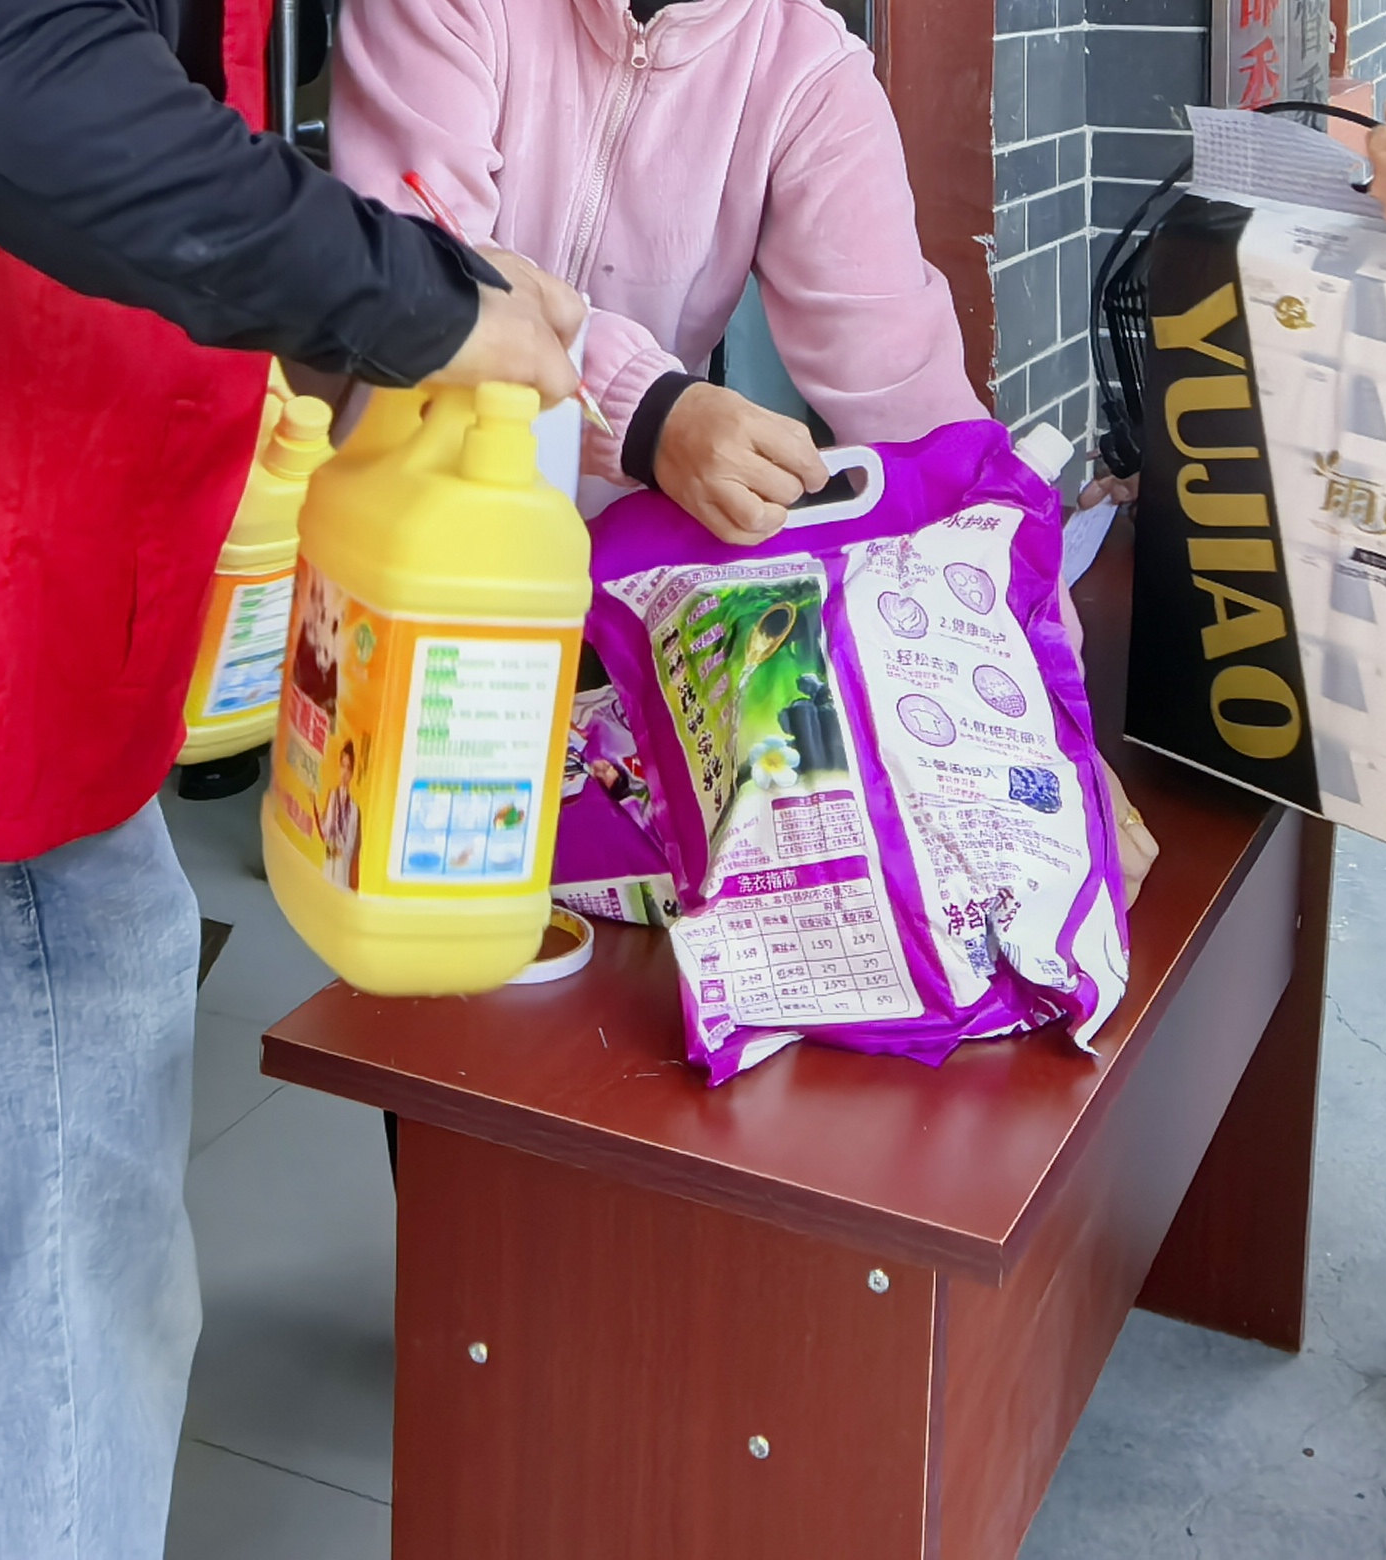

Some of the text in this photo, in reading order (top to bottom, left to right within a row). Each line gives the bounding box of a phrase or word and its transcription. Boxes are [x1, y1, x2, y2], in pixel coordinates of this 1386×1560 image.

[1148, 281, 1303, 760] YUJIAO
[737, 870, 799, 893] 洗衣指南
